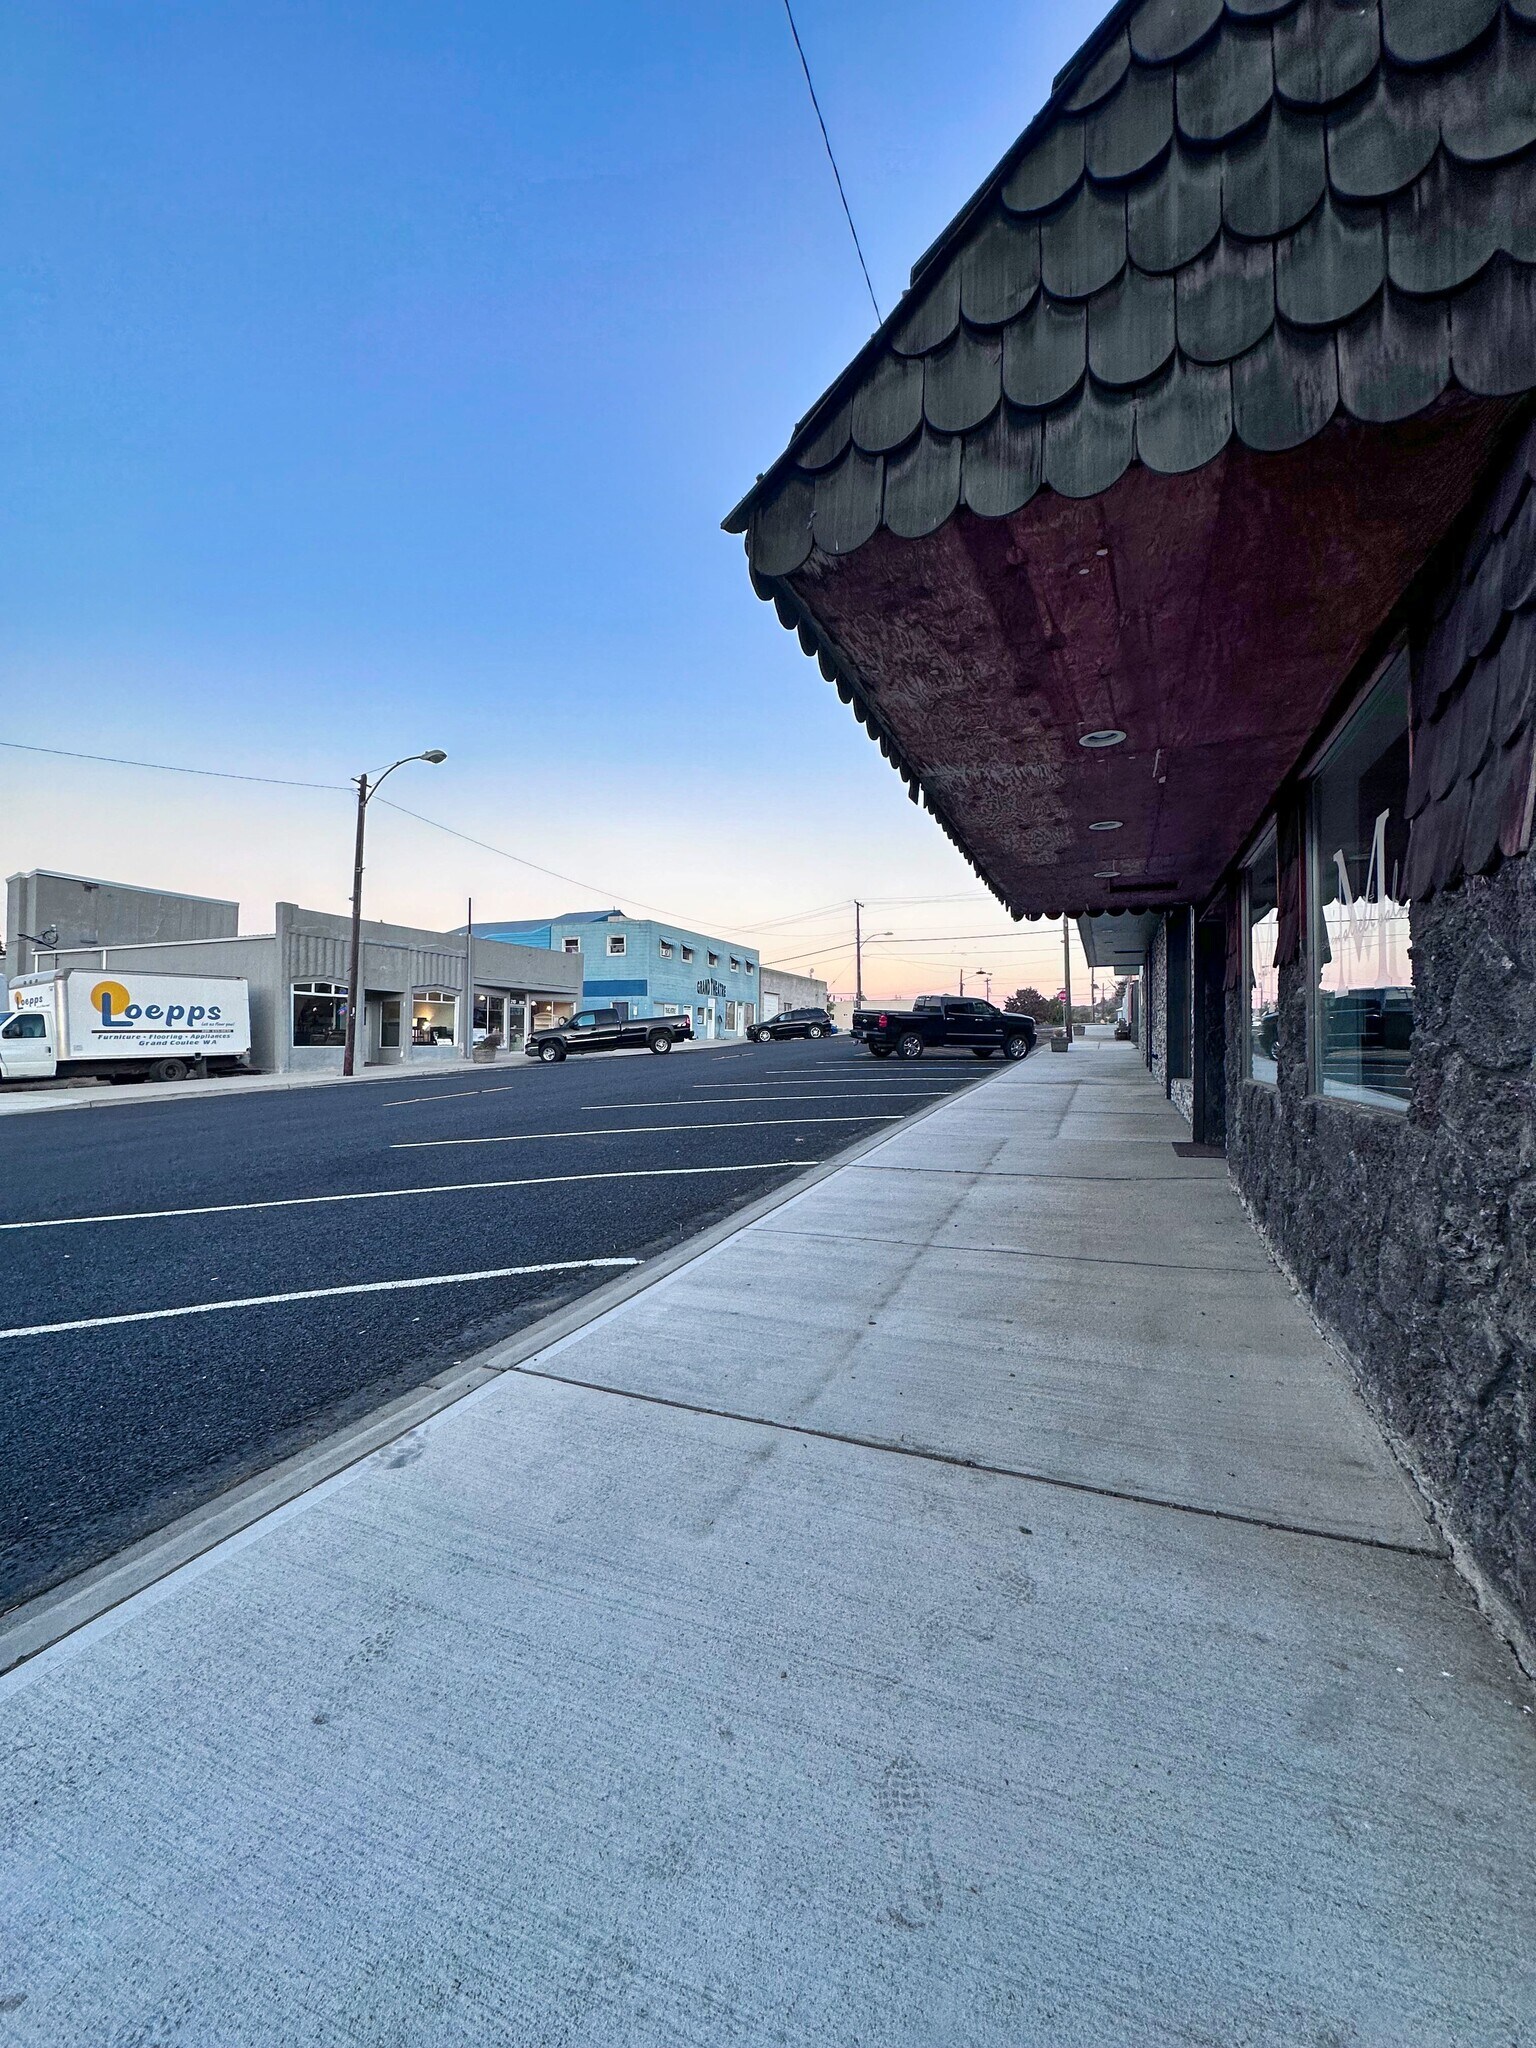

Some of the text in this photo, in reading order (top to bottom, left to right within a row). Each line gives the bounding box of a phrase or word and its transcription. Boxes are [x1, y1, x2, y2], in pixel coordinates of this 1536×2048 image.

[697, 978, 710, 996] GRAND
[16, 996, 43, 1010] Loepps
[102, 992, 222, 1027] Loepps
